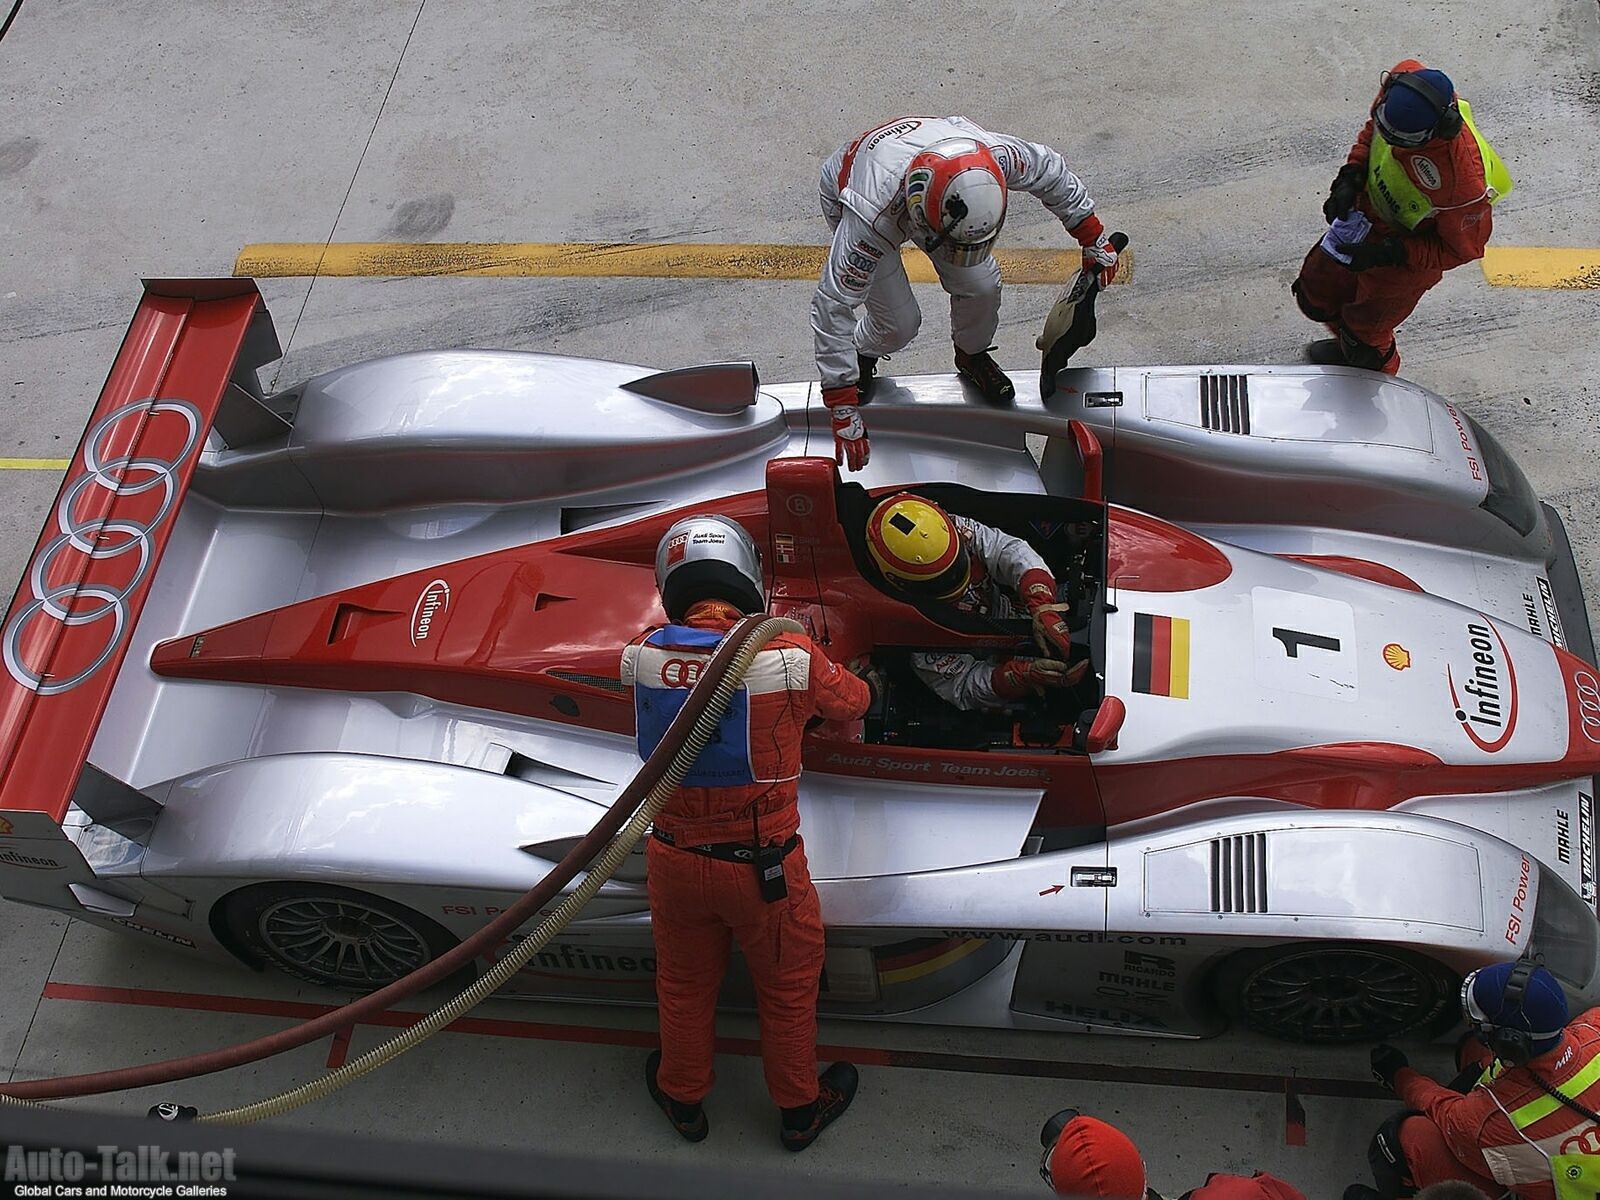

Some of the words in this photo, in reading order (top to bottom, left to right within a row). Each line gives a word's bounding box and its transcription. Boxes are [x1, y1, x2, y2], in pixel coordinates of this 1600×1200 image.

[1444, 401, 1472, 451] Power
[1467, 456, 1482, 481] FSI
[415, 590, 444, 640] Infineon
[1522, 593, 1542, 637] MAHLE
[1272, 627, 1341, 659] 1
[1457, 623, 1502, 728] Infineon
[826, 753, 873, 767] Audi
[876, 757, 931, 773] Sport
[940, 762, 990, 776] Team
[1556, 809, 1570, 865] MAHLE
[1581, 796, 1592, 878] MICHELIN
[1513, 854, 1531, 913] Power
[441, 904, 477, 917] FSI
[943, 929, 1187, 947] www.audi.com
[1505, 913, 1522, 946] FSI
[1099, 971, 1176, 993] MAHLE
[1124, 964, 1176, 978] RICARDO
